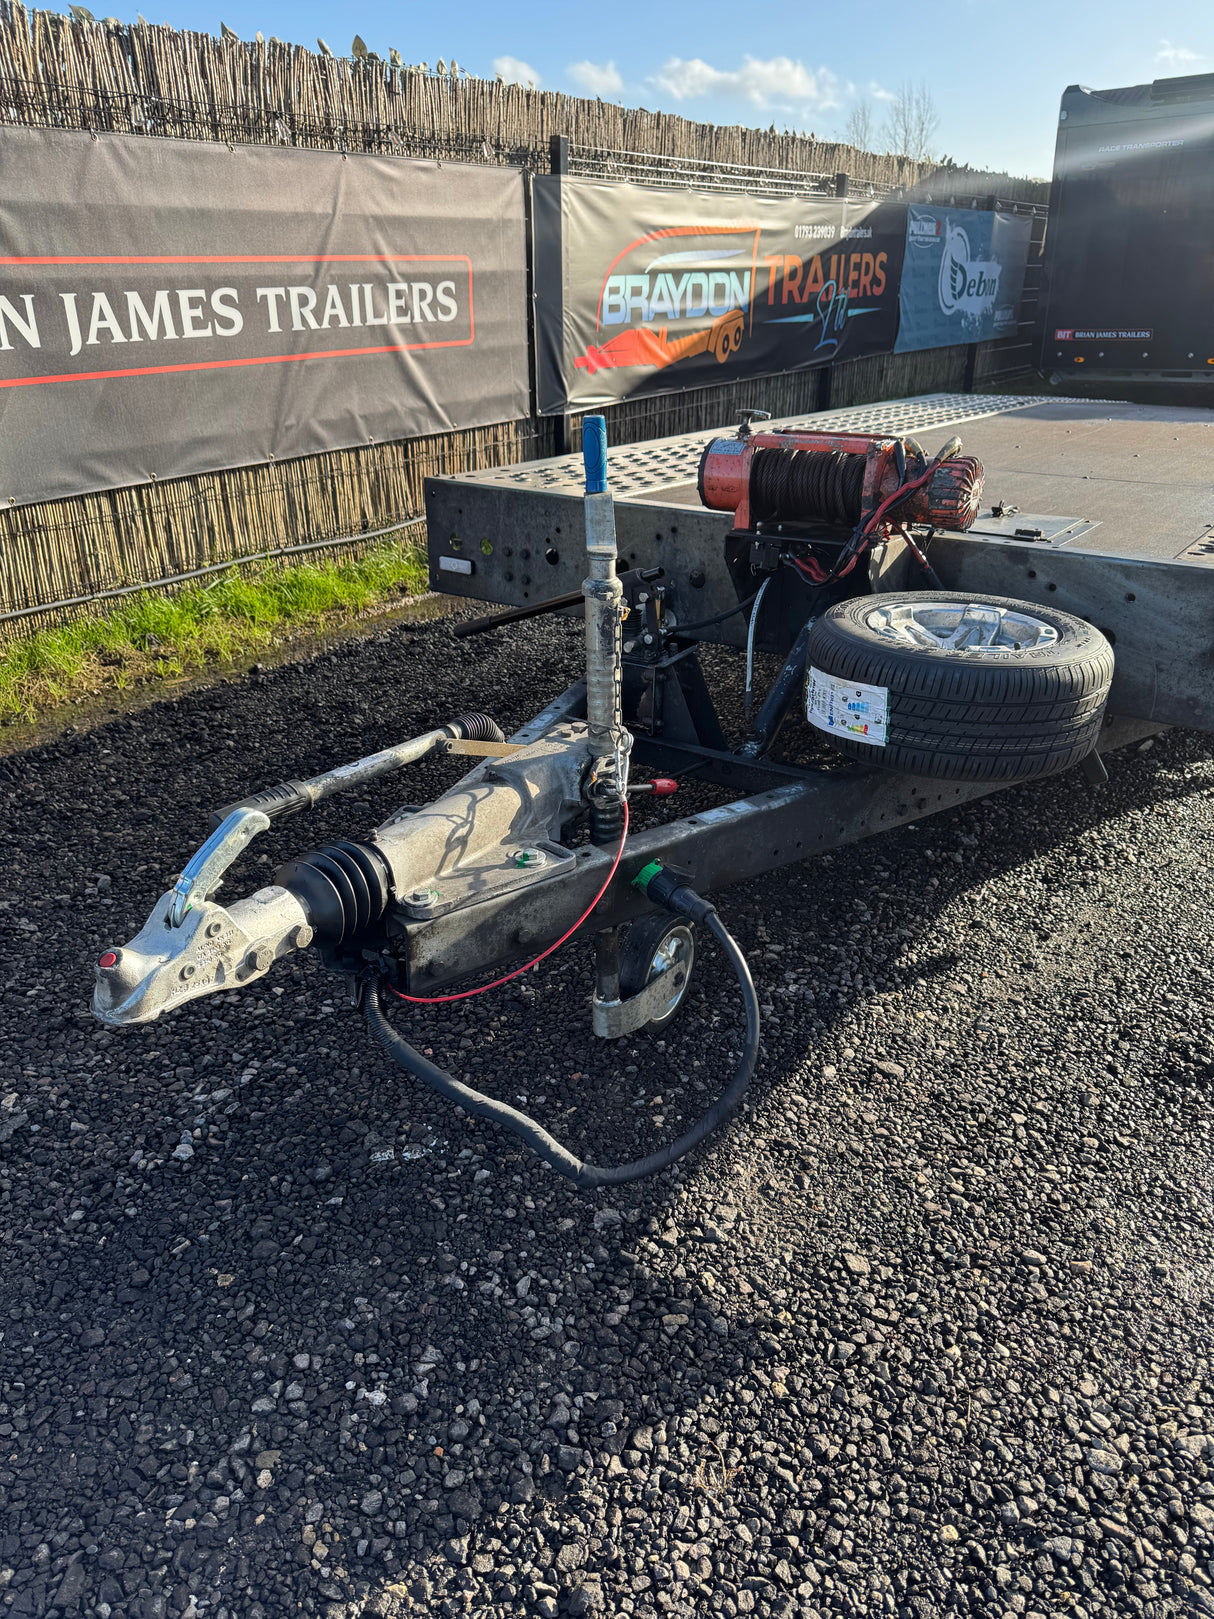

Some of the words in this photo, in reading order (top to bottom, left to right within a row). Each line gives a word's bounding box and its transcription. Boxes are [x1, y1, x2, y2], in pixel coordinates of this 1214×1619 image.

[602, 270, 752, 325] BRAYDON
[764, 251, 887, 306] TRAILERS
[58, 286, 244, 356] JAMES
[257, 280, 459, 333] TRAILERS
[1074, 330, 1096, 338] BRIAN
[1096, 330, 1117, 339] JAMES
[1118, 330, 1151, 338] TRAILERS
